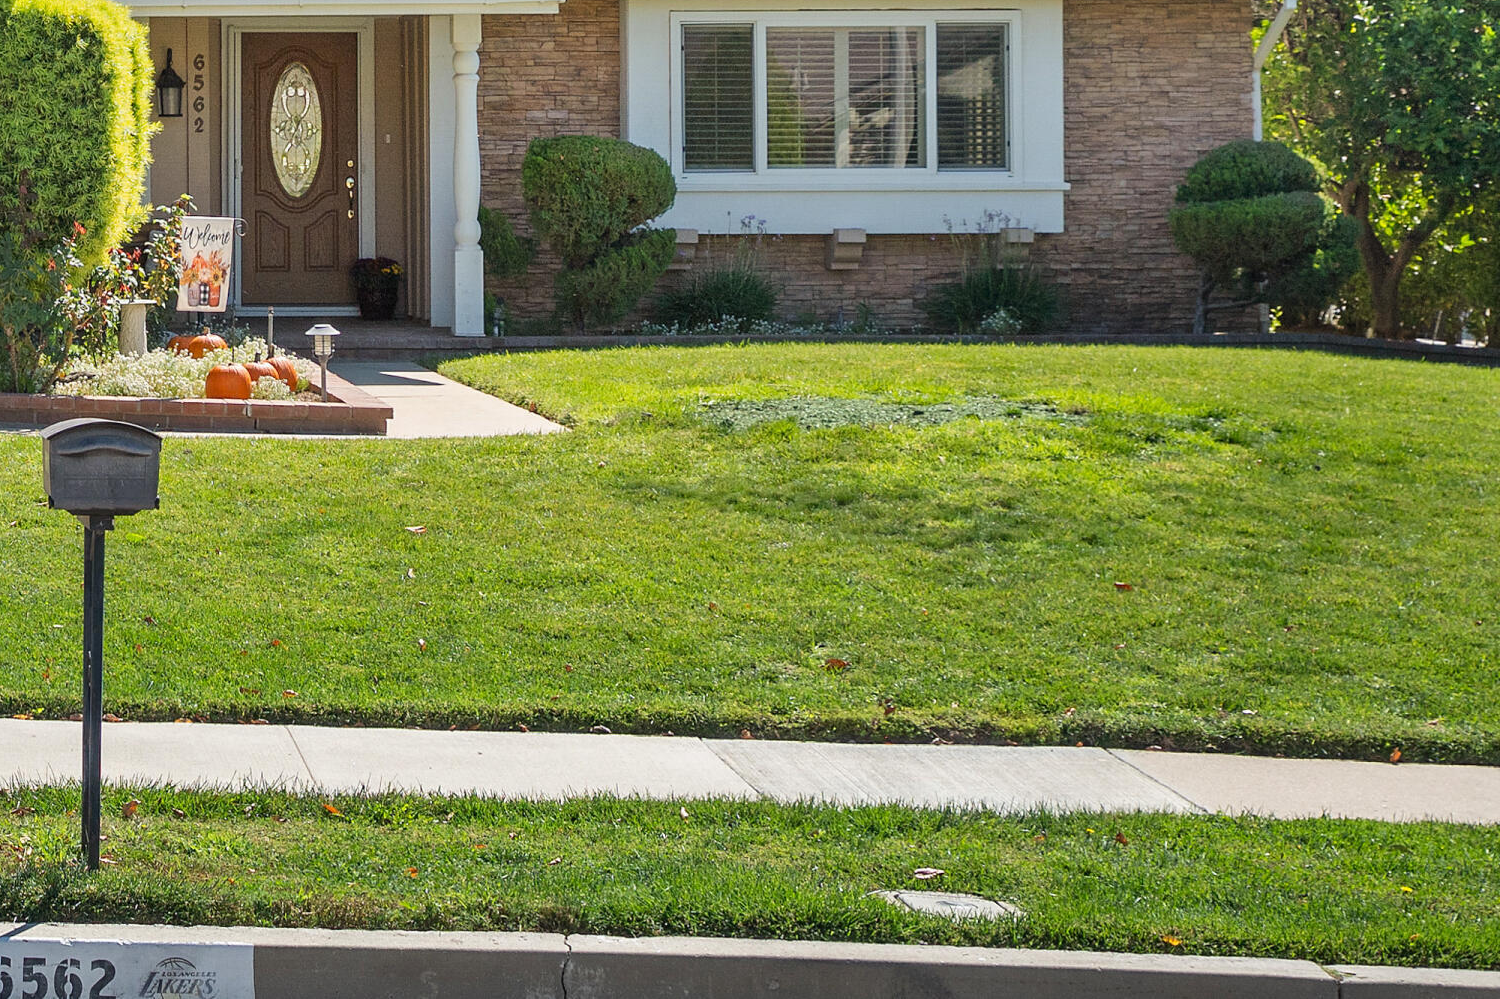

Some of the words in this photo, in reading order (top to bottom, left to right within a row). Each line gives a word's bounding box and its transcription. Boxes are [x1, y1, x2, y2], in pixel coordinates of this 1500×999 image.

[193, 54, 205, 133] 6562
[183, 223, 231, 250] Welcome
[139, 971, 216, 999] LAKERS
